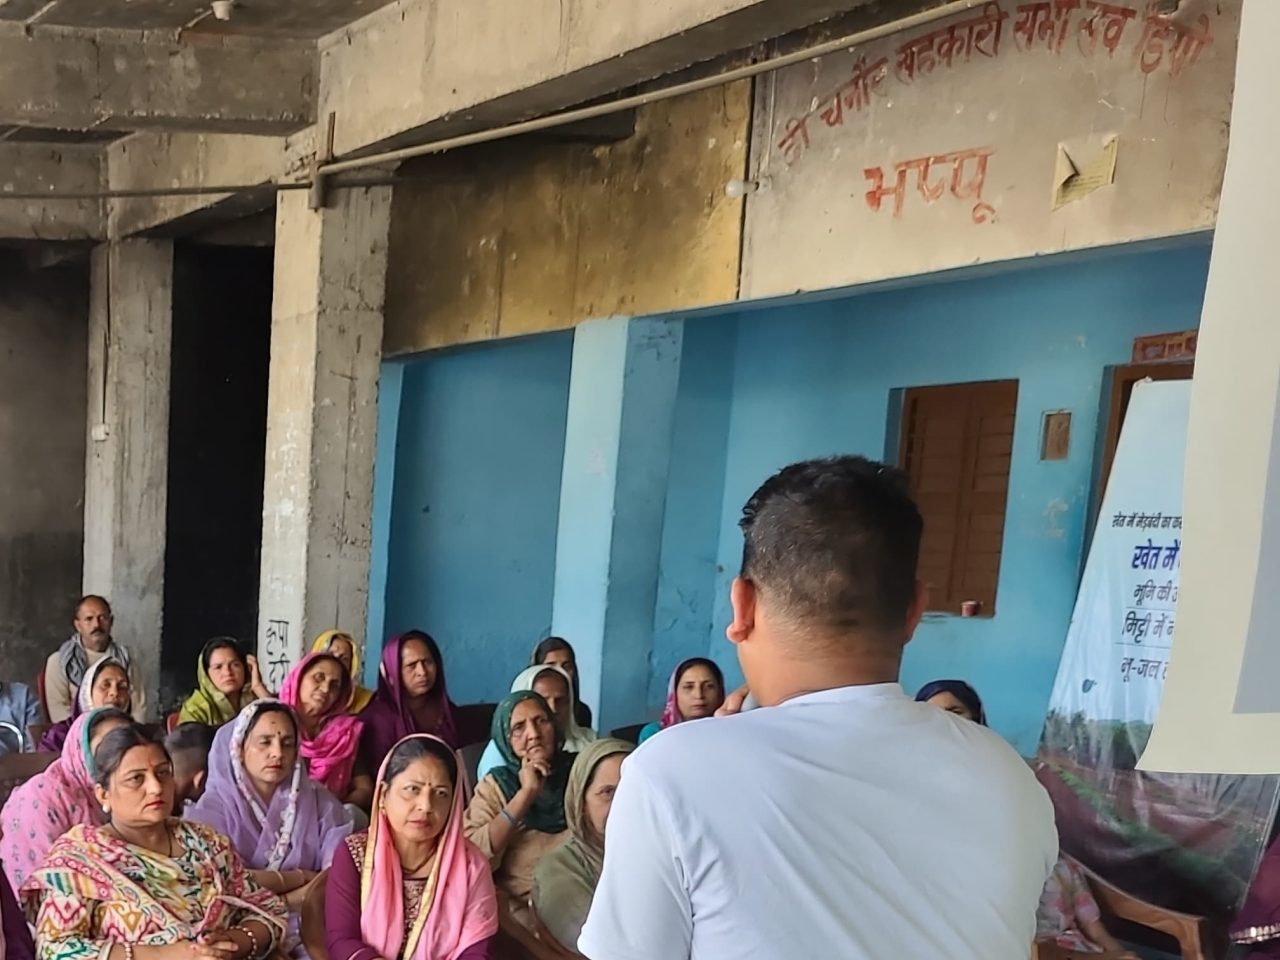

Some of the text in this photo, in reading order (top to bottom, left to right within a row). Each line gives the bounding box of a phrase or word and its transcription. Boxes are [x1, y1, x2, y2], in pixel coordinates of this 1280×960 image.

[894, 2, 1009, 85] सहकारी
[1126, 512, 1139, 528] में
[1161, 515, 1172, 529] का
[1132, 538, 1181, 571] खेत में
[1133, 578, 1157, 606] भूमि
[1156, 580, 1172, 602] की
[1121, 610, 1152, 643] मिट्टी
[1152, 612, 1168, 638] में
[1120, 657, 1161, 683] भू-जल
